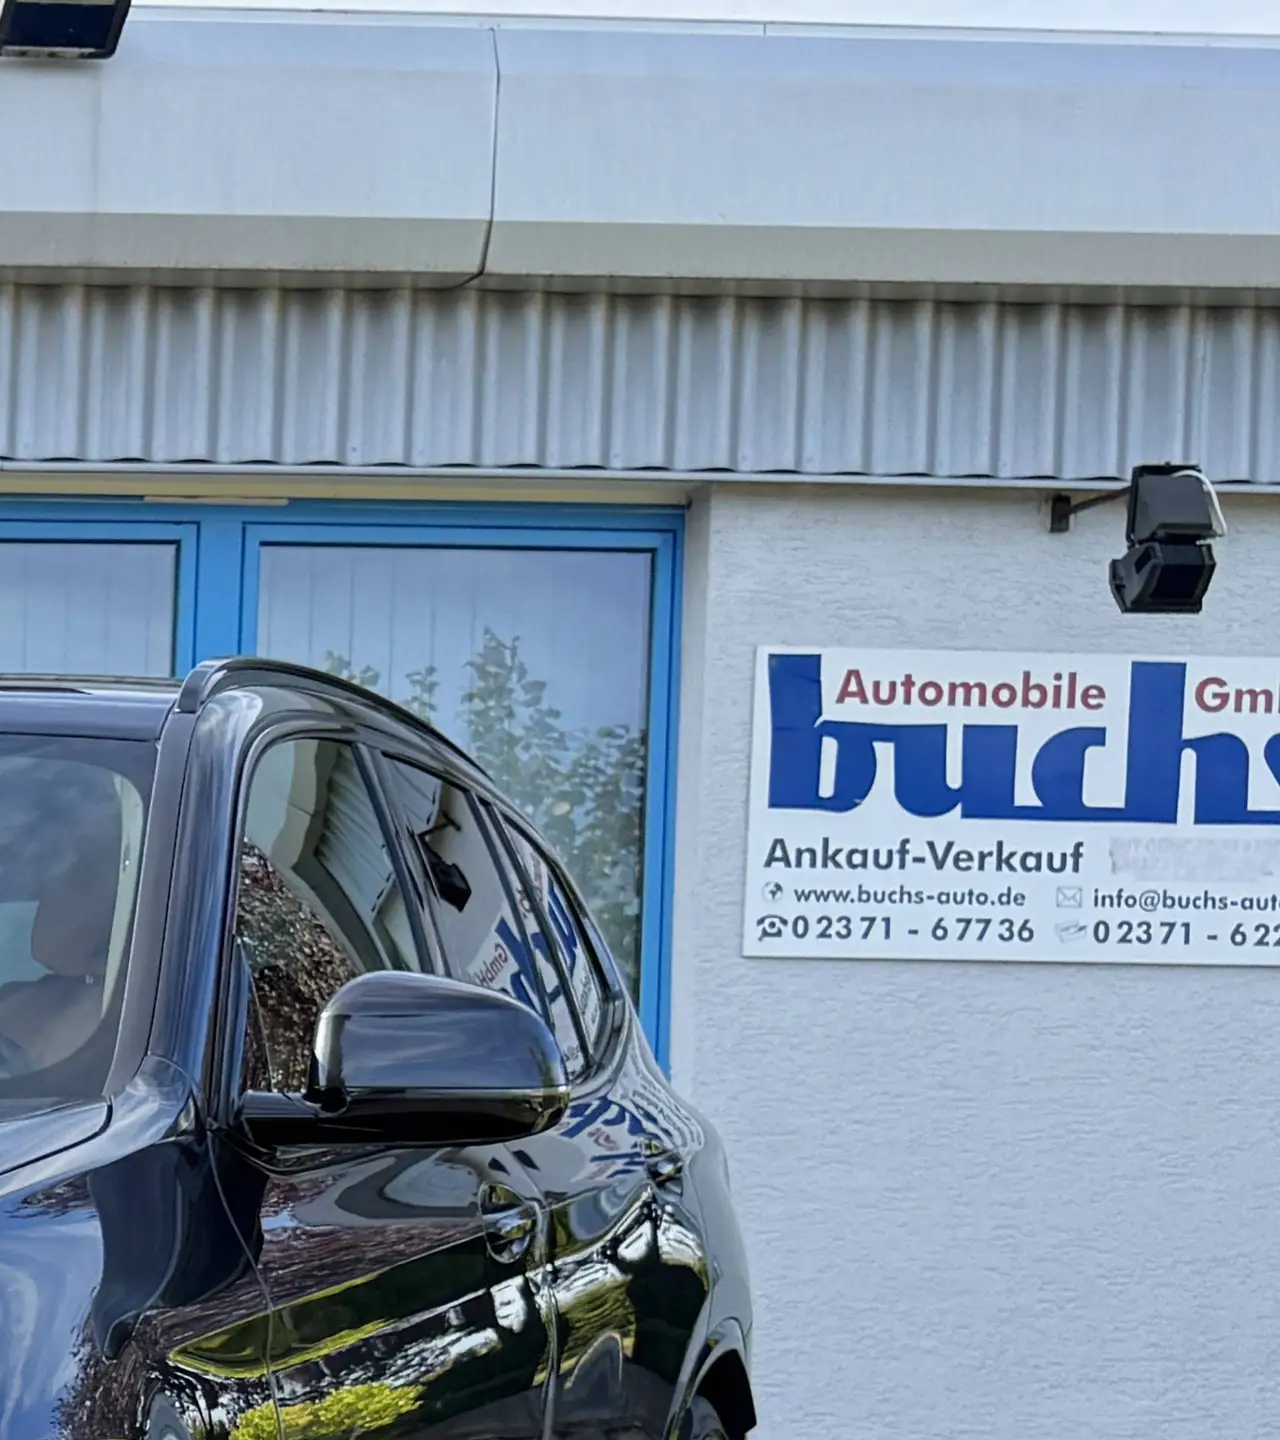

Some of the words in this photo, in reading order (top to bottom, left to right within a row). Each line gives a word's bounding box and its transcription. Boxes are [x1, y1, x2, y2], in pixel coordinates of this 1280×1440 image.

[836, 669, 1107, 711] Automobile
[1195, 676, 1280, 714] Gm
[768, 653, 1280, 825] buch
[762, 837, 1084, 874] Ankauf-Verkauf
[793, 883, 1027, 907] www.buchs-auto.de
[1093, 887, 1280, 912] info@buchs-aut
